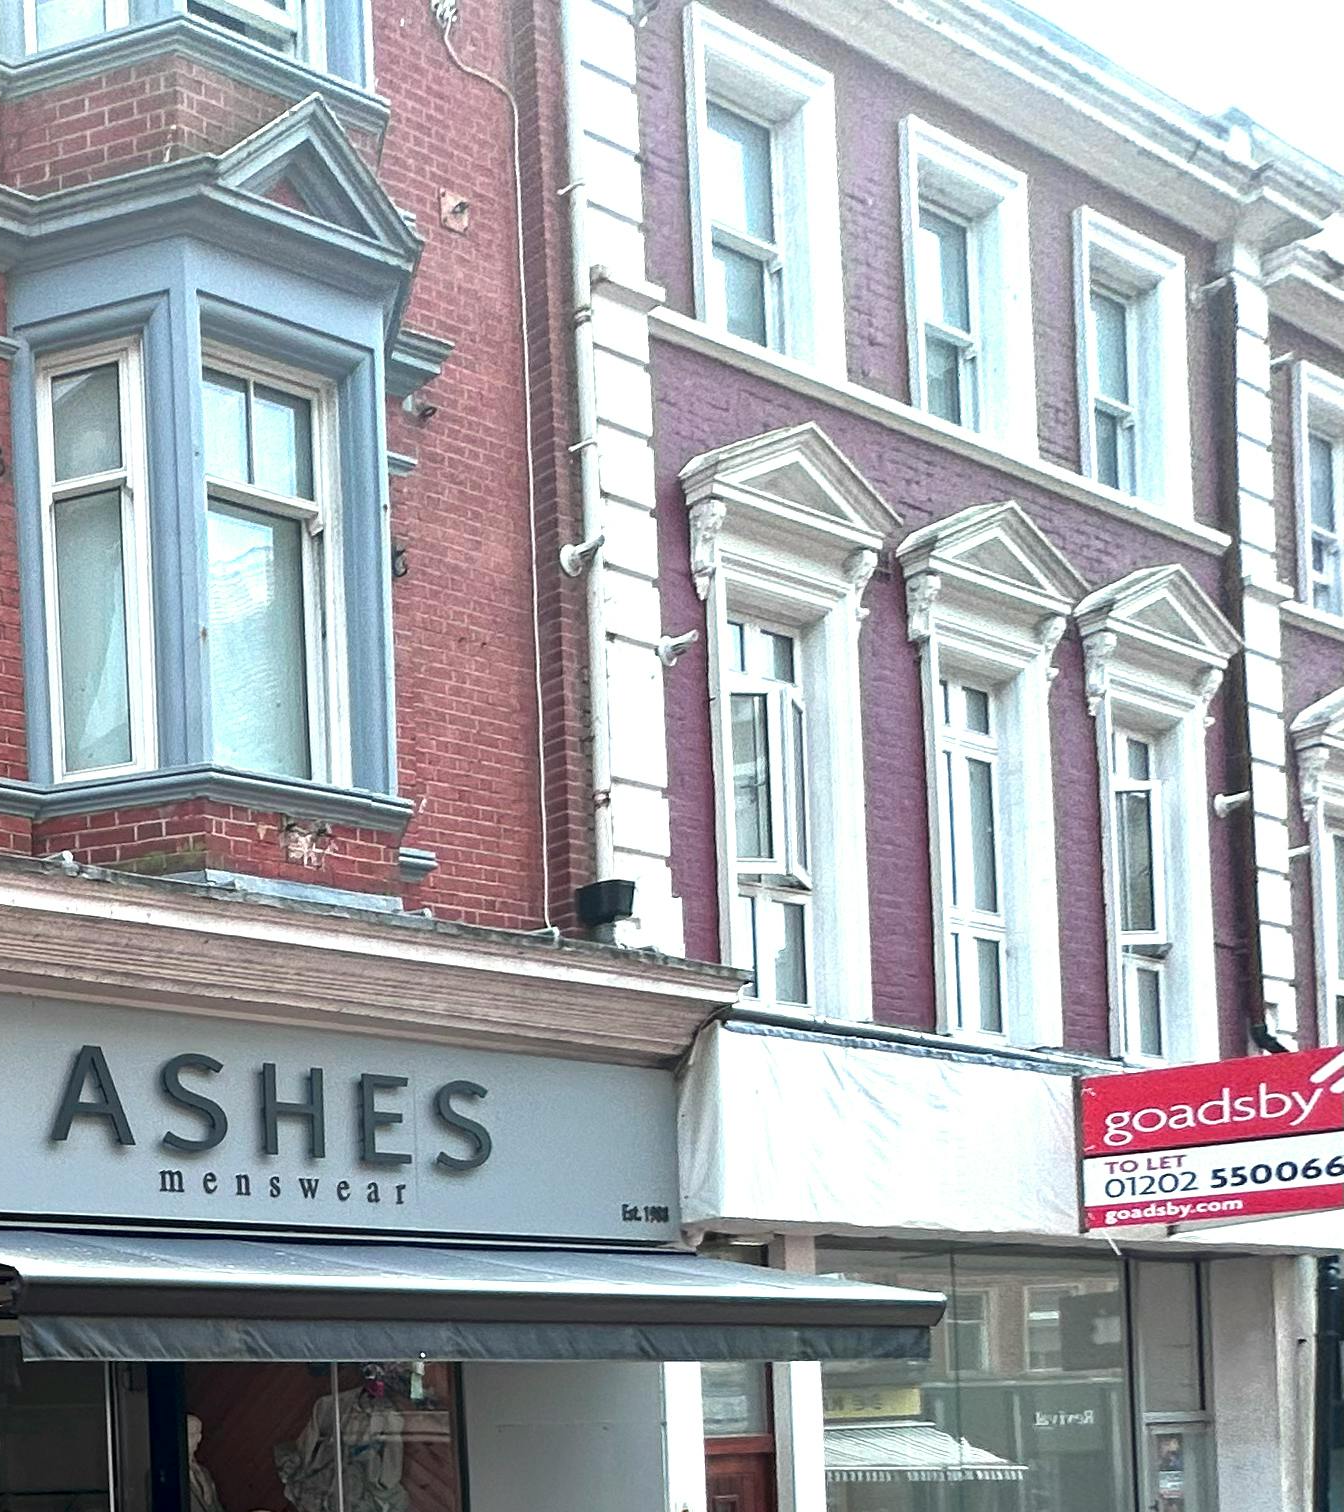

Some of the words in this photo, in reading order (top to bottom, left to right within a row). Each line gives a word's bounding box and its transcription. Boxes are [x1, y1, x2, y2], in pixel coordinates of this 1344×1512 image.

[51, 1044, 493, 1171] ASHES
[1103, 1082, 1324, 1147] goadsby
[1105, 1159, 1139, 1174] TO
[1146, 1154, 1187, 1171] LET
[1105, 1171, 1199, 1198] 01202
[1210, 1155, 1344, 1189] 550066
[159, 1168, 407, 1205] menswear
[1105, 1200, 1243, 1225] goadsby.com
